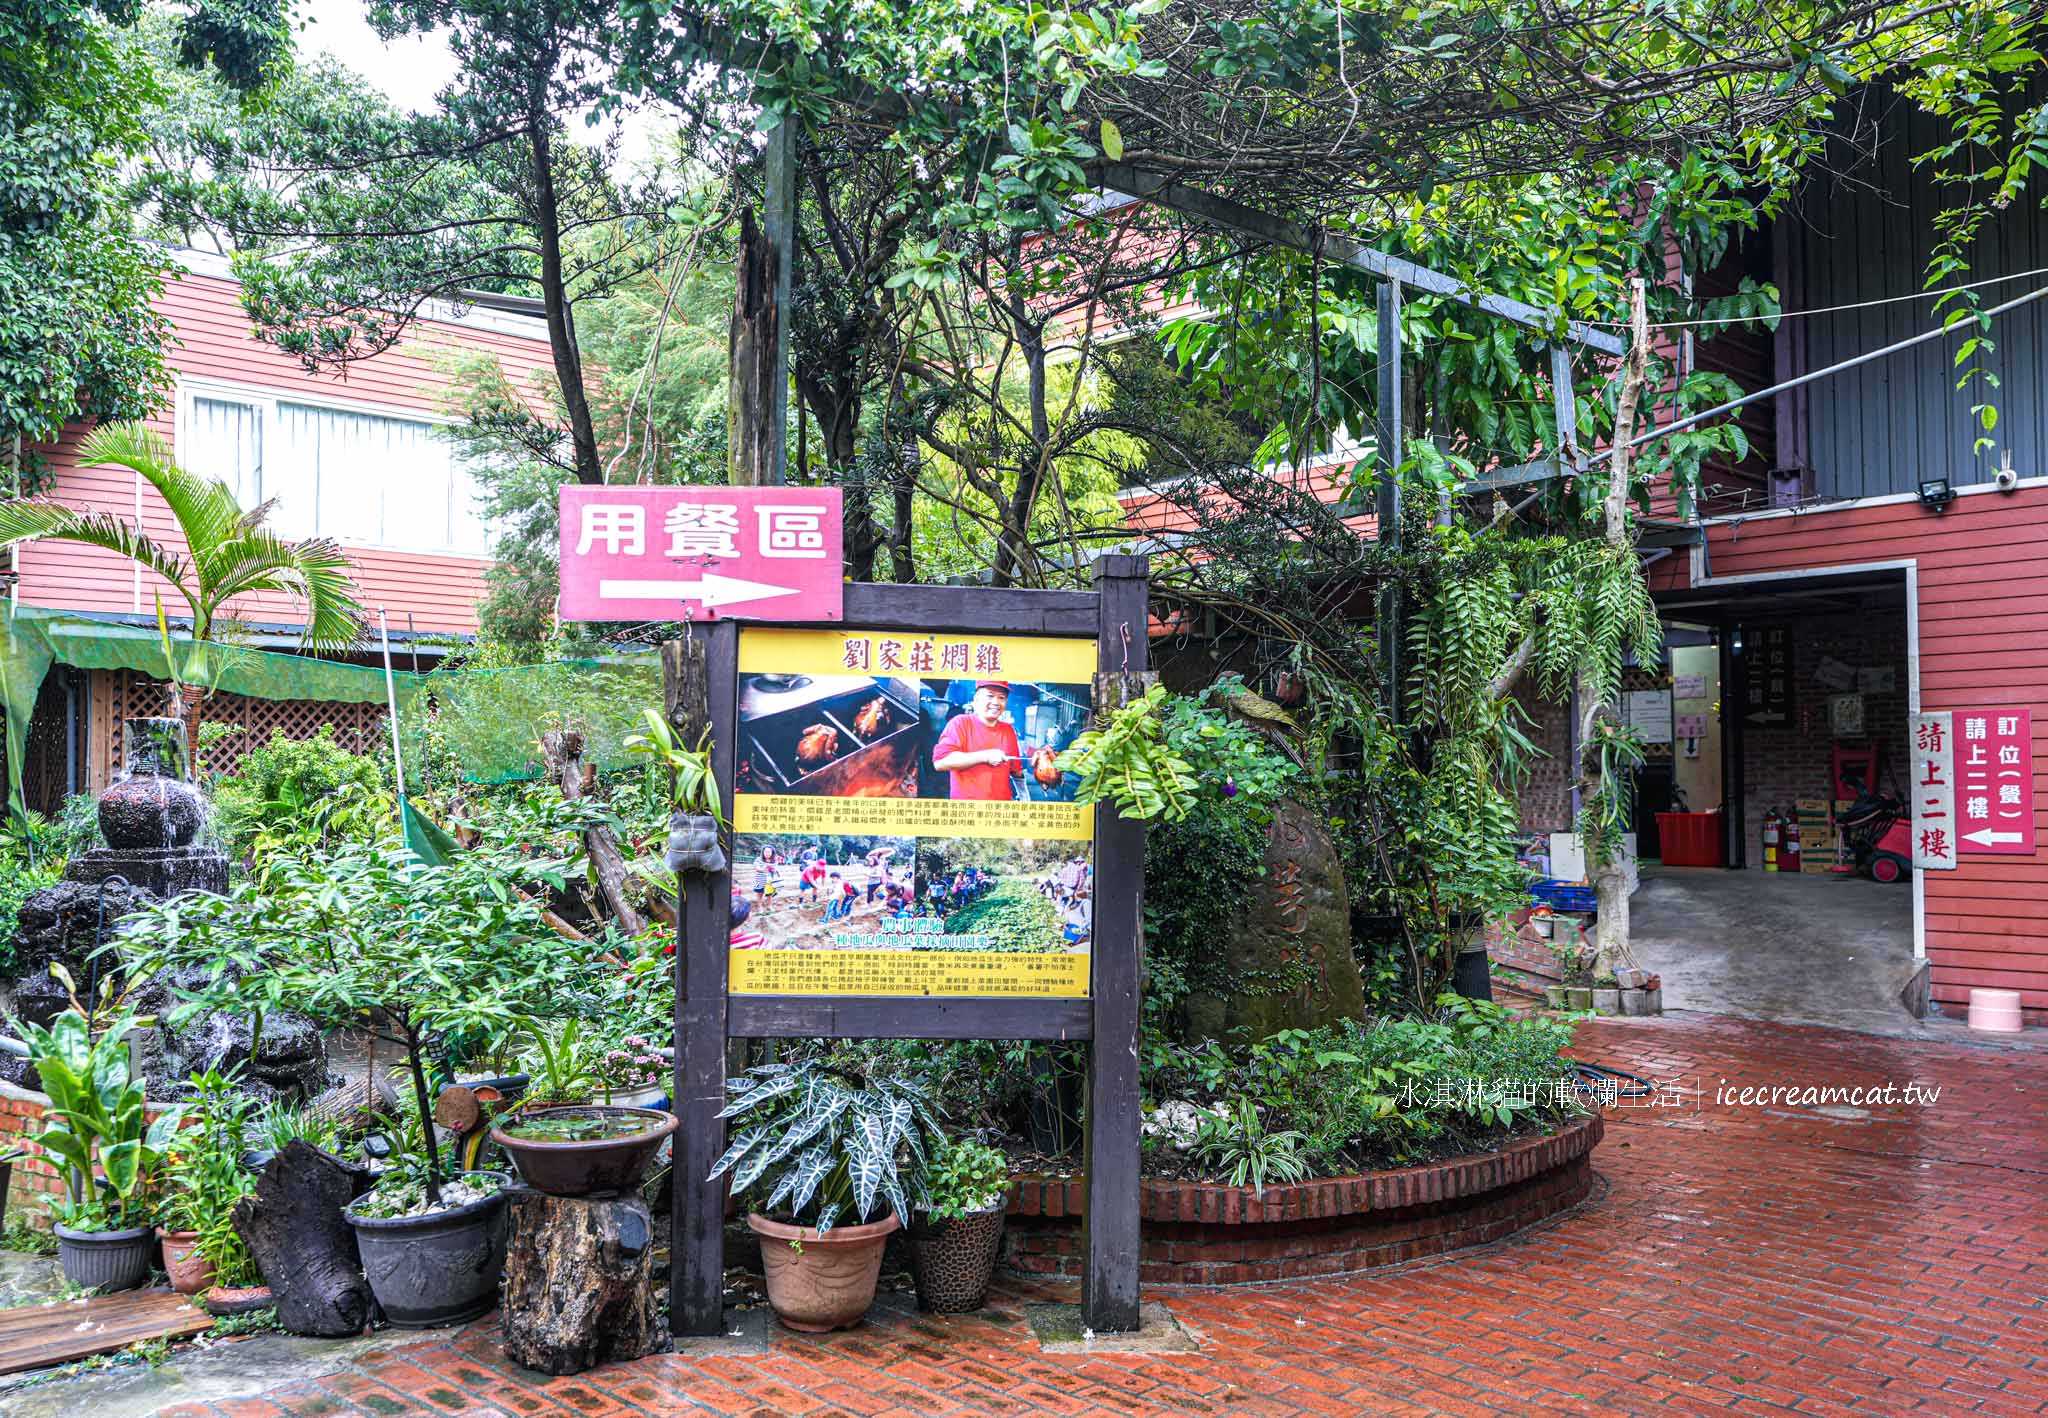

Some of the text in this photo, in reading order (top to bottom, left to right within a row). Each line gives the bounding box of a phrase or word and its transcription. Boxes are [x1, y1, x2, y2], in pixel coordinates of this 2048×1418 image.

[576, 502, 828, 558] 用餐區
[842, 638, 1002, 674] 劉家莊燜雞
[1915, 722, 1950, 859] 請上二樓
[1965, 718, 1989, 819] 請上二樓
[1997, 717, 2023, 818] 訂位(餐)
